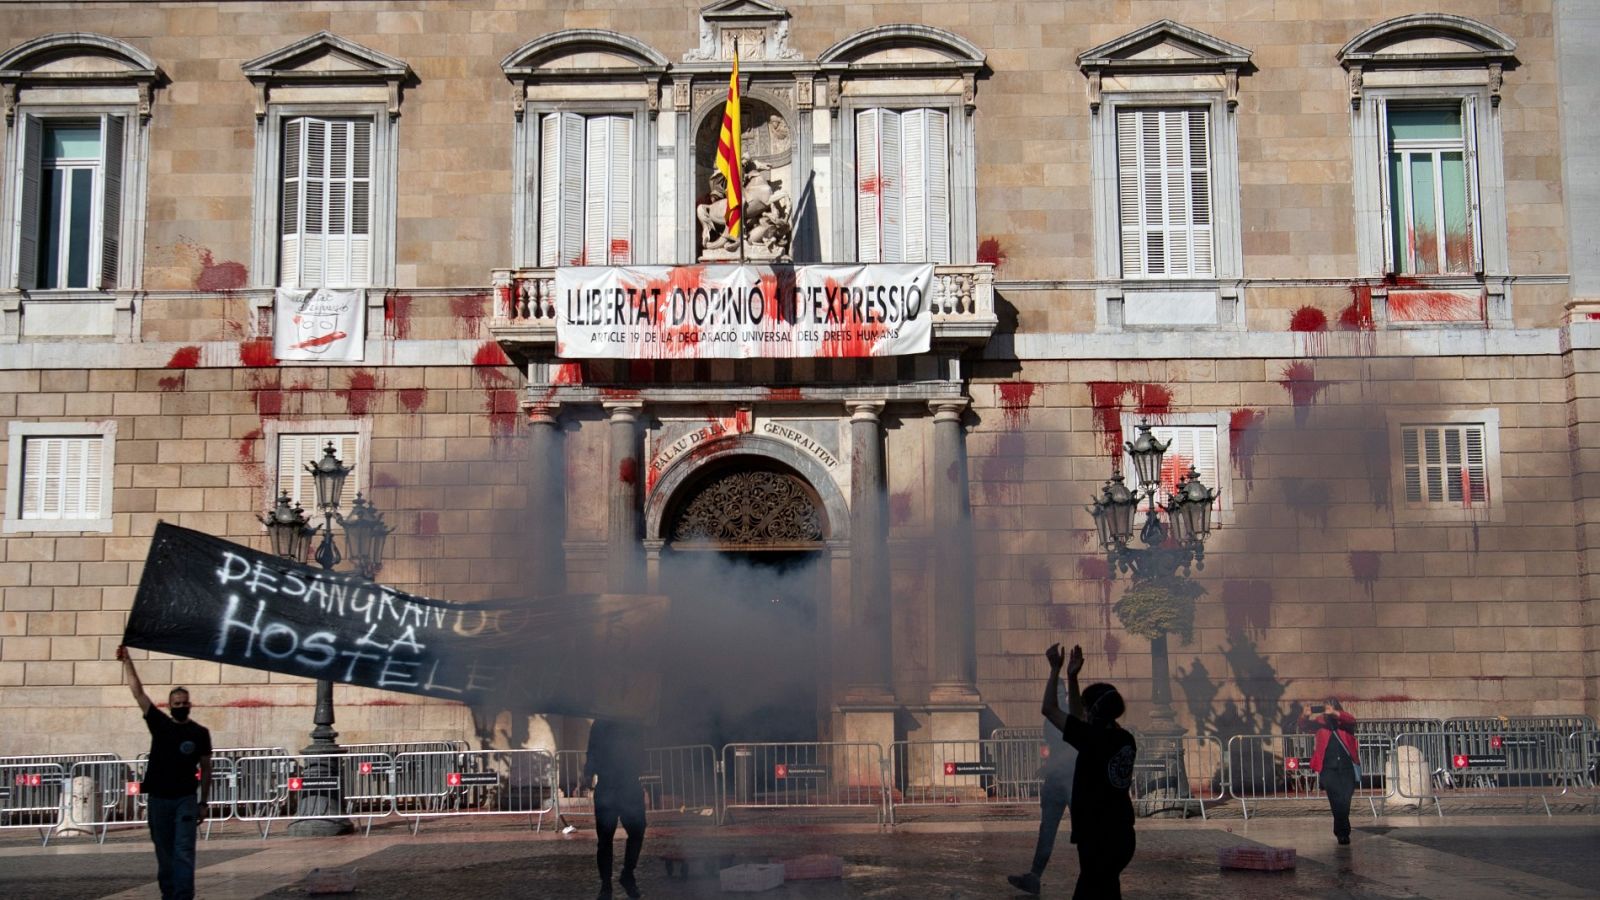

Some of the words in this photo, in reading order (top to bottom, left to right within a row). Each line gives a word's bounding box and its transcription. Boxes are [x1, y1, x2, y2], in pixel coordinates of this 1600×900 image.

[567, 288, 662, 326] LLIBERTAT
[672, 279, 765, 326] D'OPINIÓ
[794, 276, 923, 325] D'EXPRESSIÓ
[631, 332, 640, 343] 19
[645, 332, 657, 343] DE
[662, 331, 673, 343] LA
[679, 328, 738, 343] DECLARACIÓ
[742, 330, 792, 343] UNIVERSAL
[798, 330, 819, 342] DELS
[824, 330, 852, 342] DRETS
[857, 328, 899, 342] HUMANS
[654, 438, 688, 471] PALAU
[691, 429, 708, 444] DE
[710, 421, 727, 437] LA
[763, 422, 838, 469] GENERALITAT
[355, 623, 426, 654] LA
